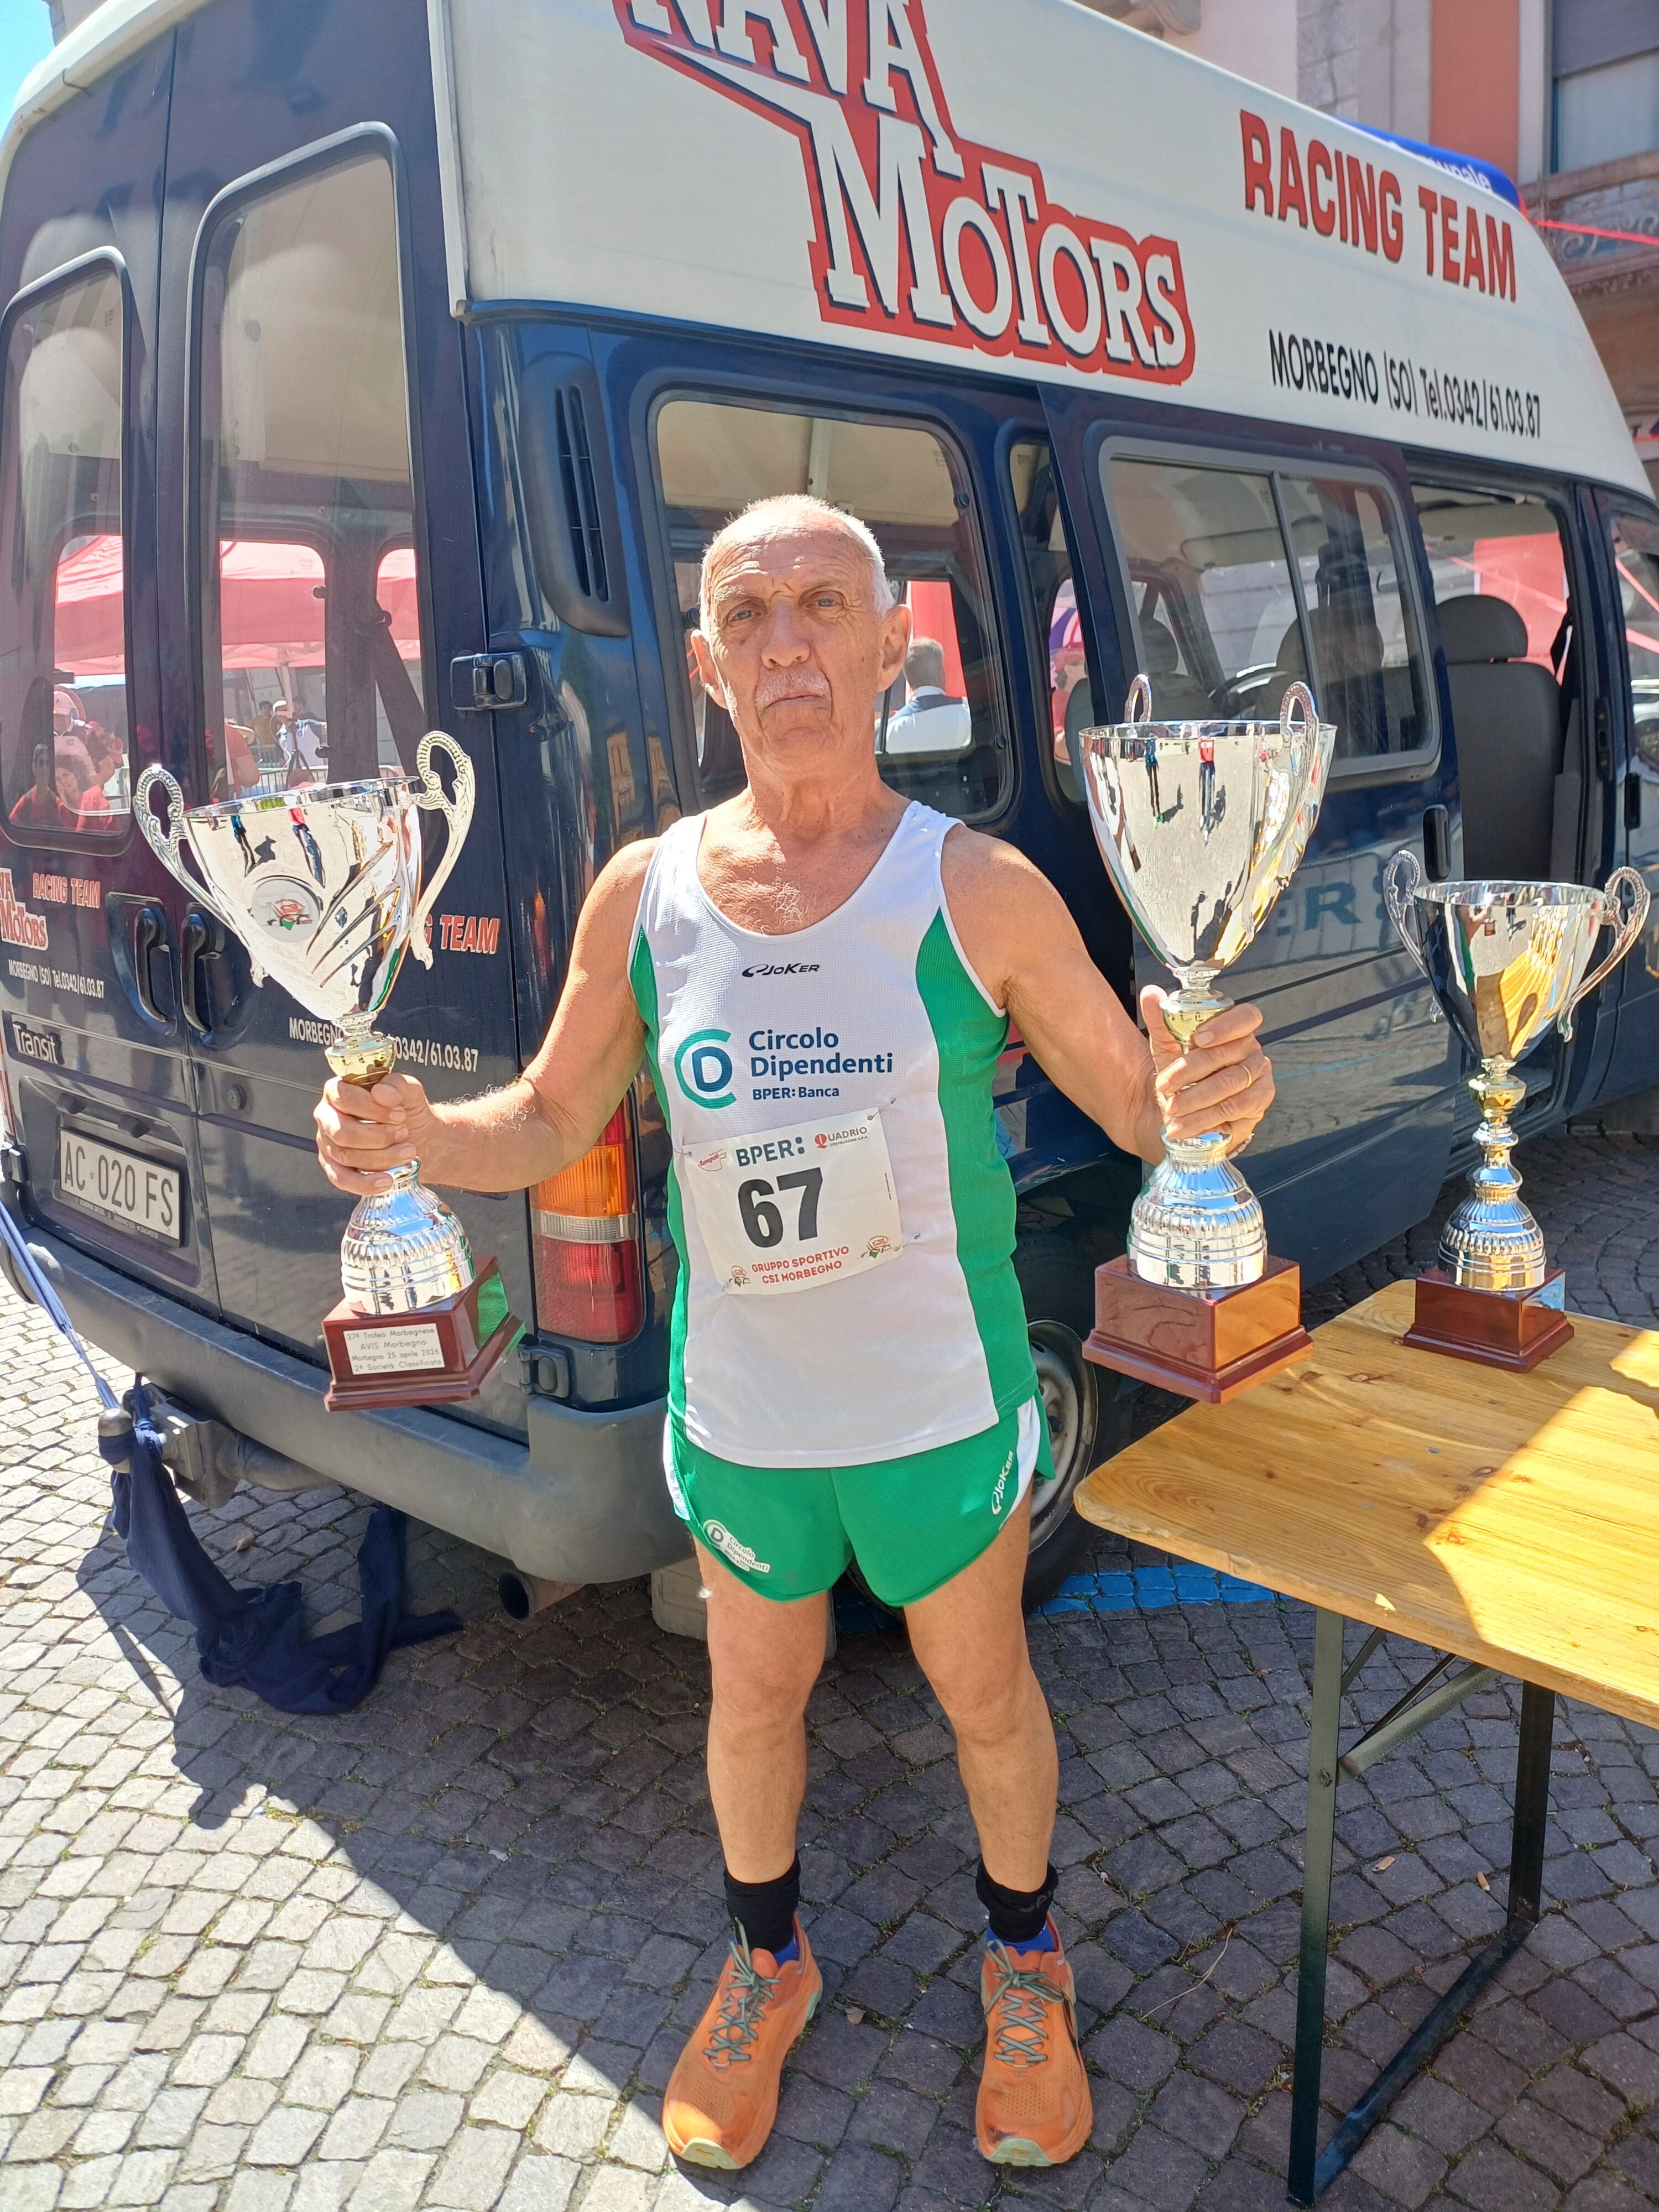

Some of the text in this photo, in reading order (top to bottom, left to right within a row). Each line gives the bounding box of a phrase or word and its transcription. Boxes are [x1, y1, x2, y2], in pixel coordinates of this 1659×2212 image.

[1240, 109, 1516, 303] RACING TEAM
[1269, 328, 1379, 405] MORBEGNO
[33, 872, 101, 909] RACING TEAM
[440, 914, 500, 955] TEAM
[8, 959, 38, 983] MORBEGNO
[13, 1023, 58, 1065] Transit
[749, 1027, 839, 1051] Circolo
[750, 1052, 894, 1082] Dipendenti
[815, 1126, 868, 1149] QUADRIO
[64, 1141, 86, 1191] AC
[98, 1154, 135, 1212] 020
[145, 1170, 174, 1228] FS
[738, 1167, 823, 1248] 67
[752, 1245, 849, 1273] GRUPPO SPORTIVO
[761, 1260, 843, 1284] CSI MORBEGNO
[361, 1340, 426, 1350] AVIS Morbegno
[390, 1328, 435, 1337] Morbegnese
[727, 1542, 769, 1571] Dipendenti
[729, 1537, 754, 1558] Circolo
